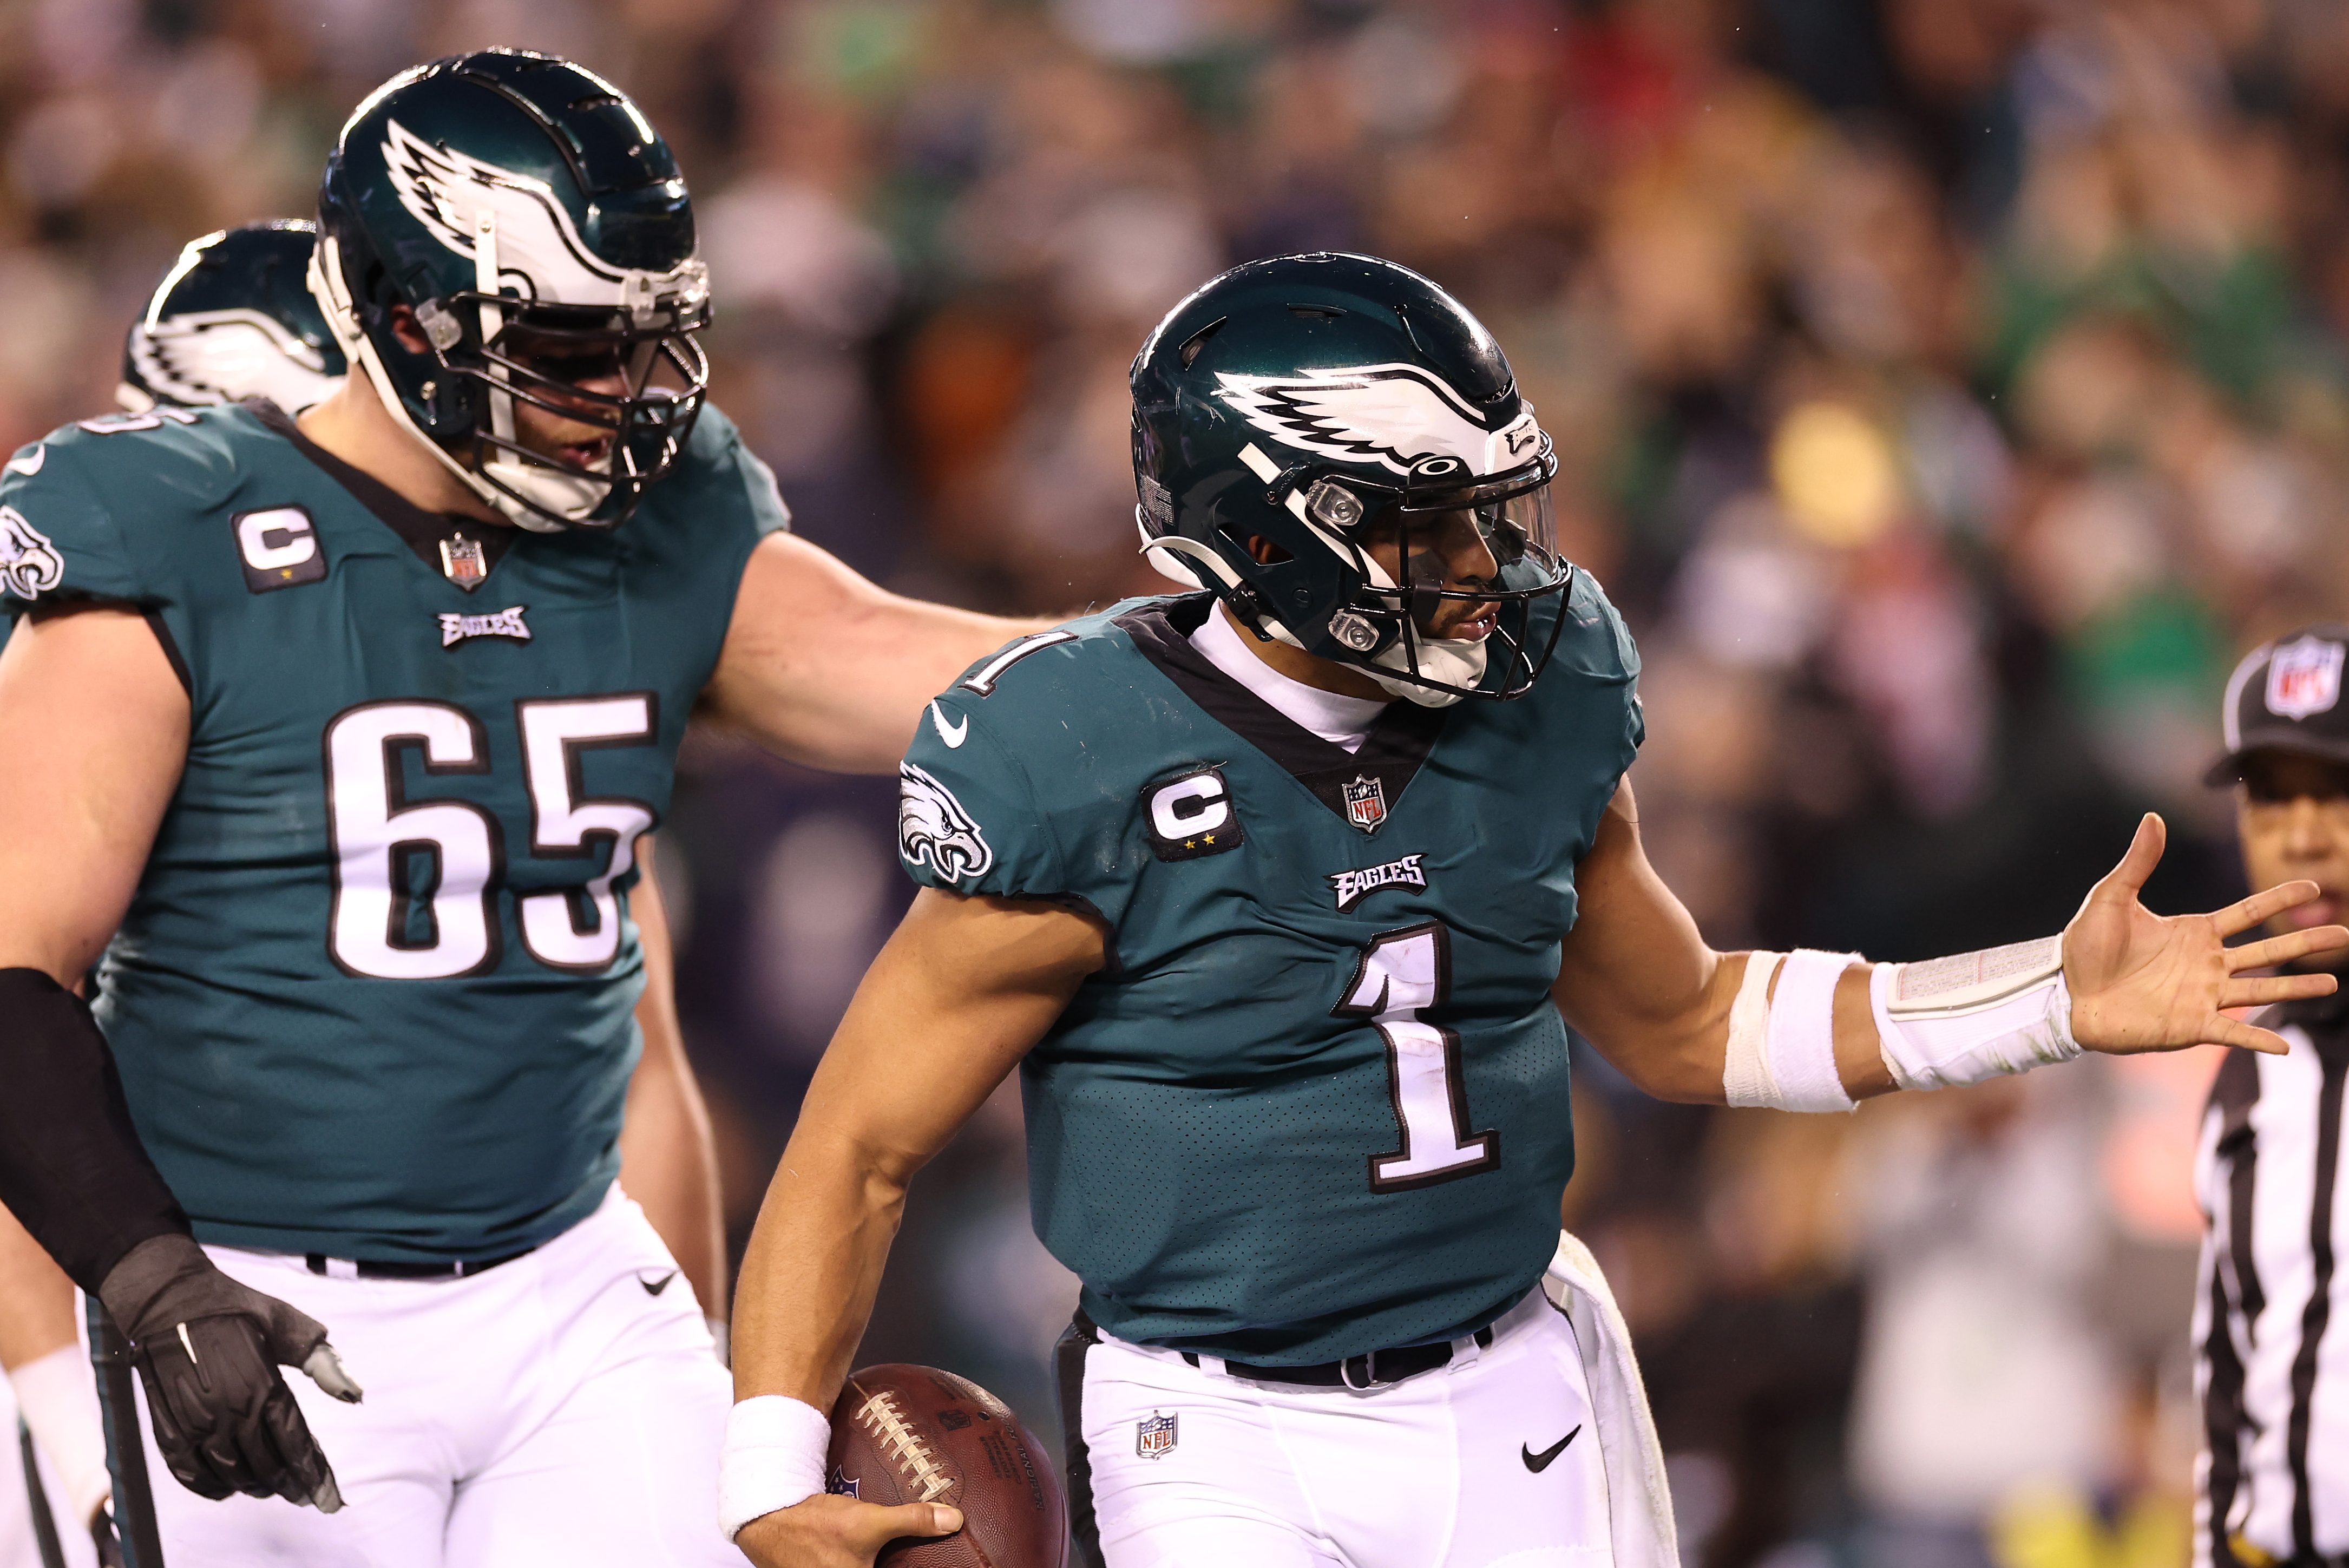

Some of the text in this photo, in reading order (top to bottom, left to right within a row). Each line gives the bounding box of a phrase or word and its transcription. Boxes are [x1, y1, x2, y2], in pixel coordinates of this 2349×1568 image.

[239, 507, 316, 570] C
[959, 629, 1079, 698] 1
[326, 696, 656, 979] 65
[1151, 775, 1228, 840] C
[1353, 798, 1381, 821] NFL
[1330, 854, 1427, 909] EAGLES
[1334, 923, 1495, 1190] 1
[1143, 1431, 1171, 1449] NFL
